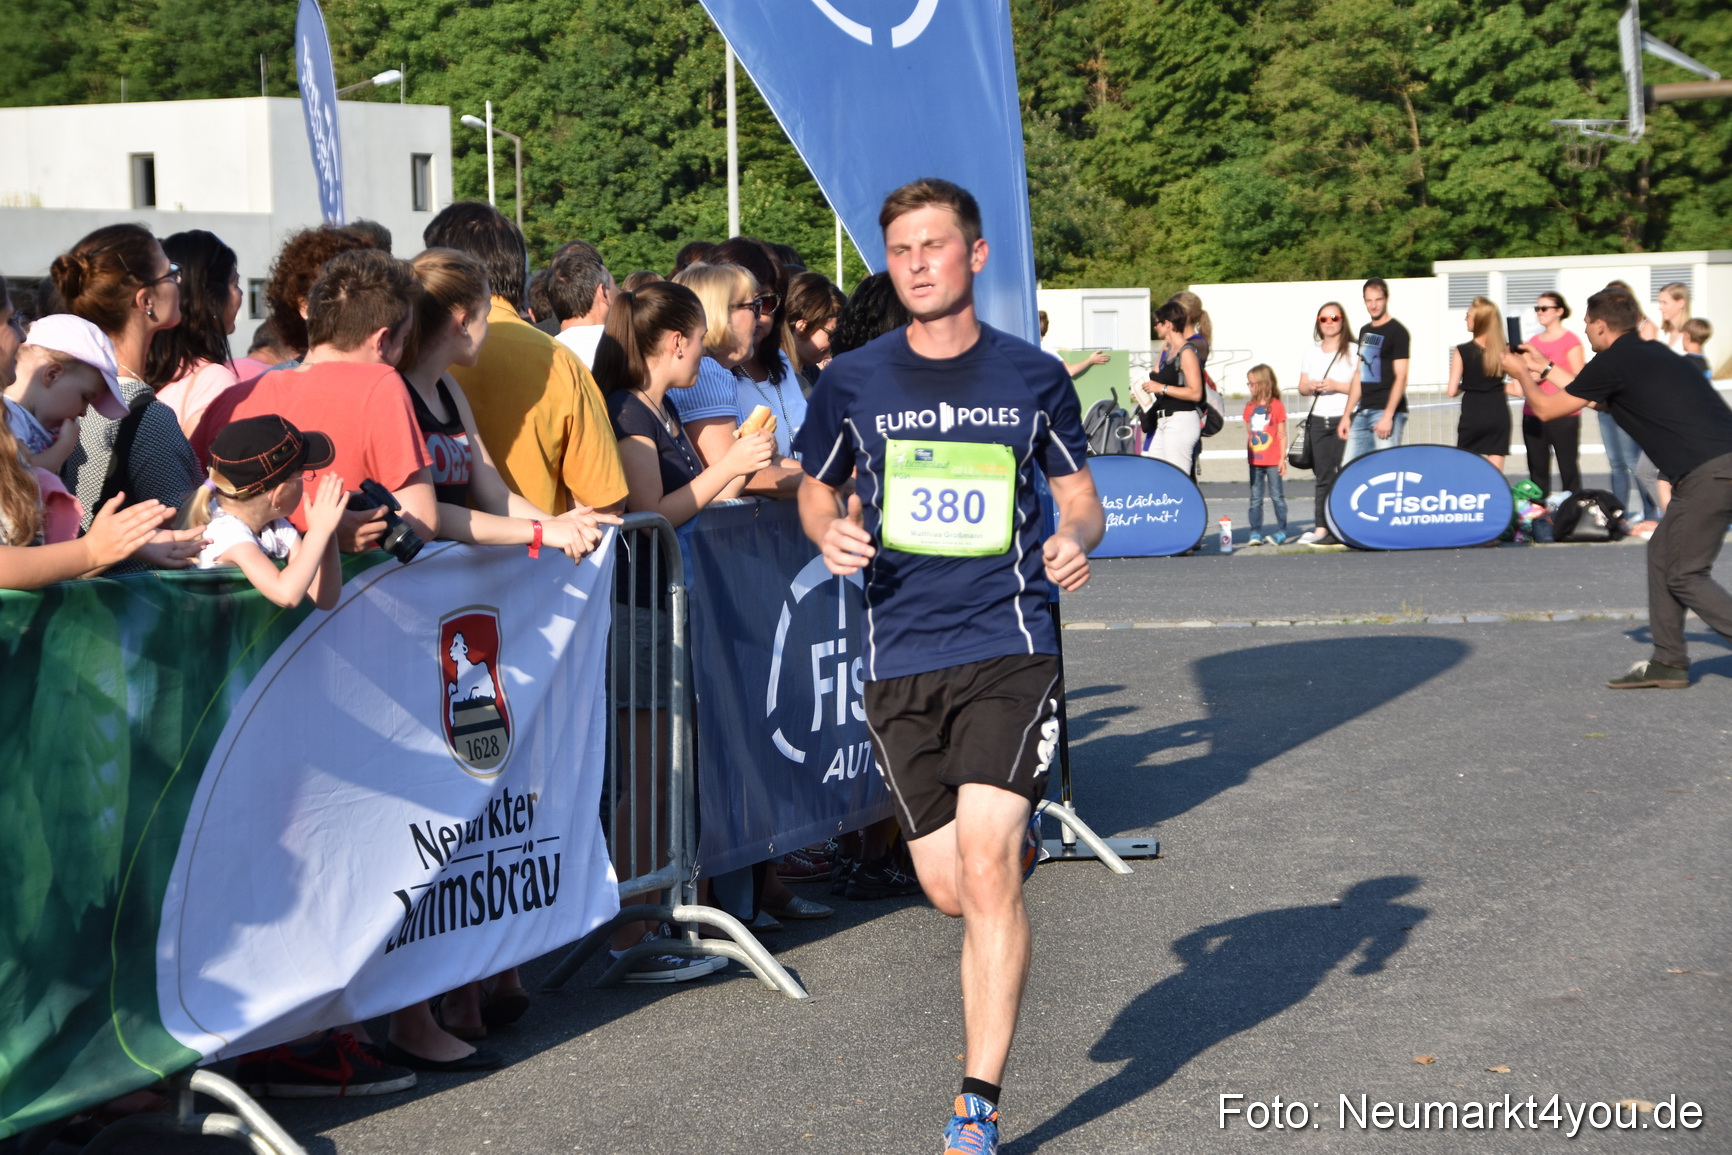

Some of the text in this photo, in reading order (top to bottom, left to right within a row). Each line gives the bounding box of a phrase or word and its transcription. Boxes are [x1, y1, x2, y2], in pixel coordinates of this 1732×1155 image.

[875, 406, 1021, 434] EURO POLES
[910, 487, 986, 525] 380
[1125, 492, 1184, 509] Lächeln
[1376, 488, 1492, 516] Fischer
[1105, 508, 1180, 533] fährt mit!
[1389, 511, 1485, 527] AUTOMOBILE
[465, 734, 501, 762] 1628
